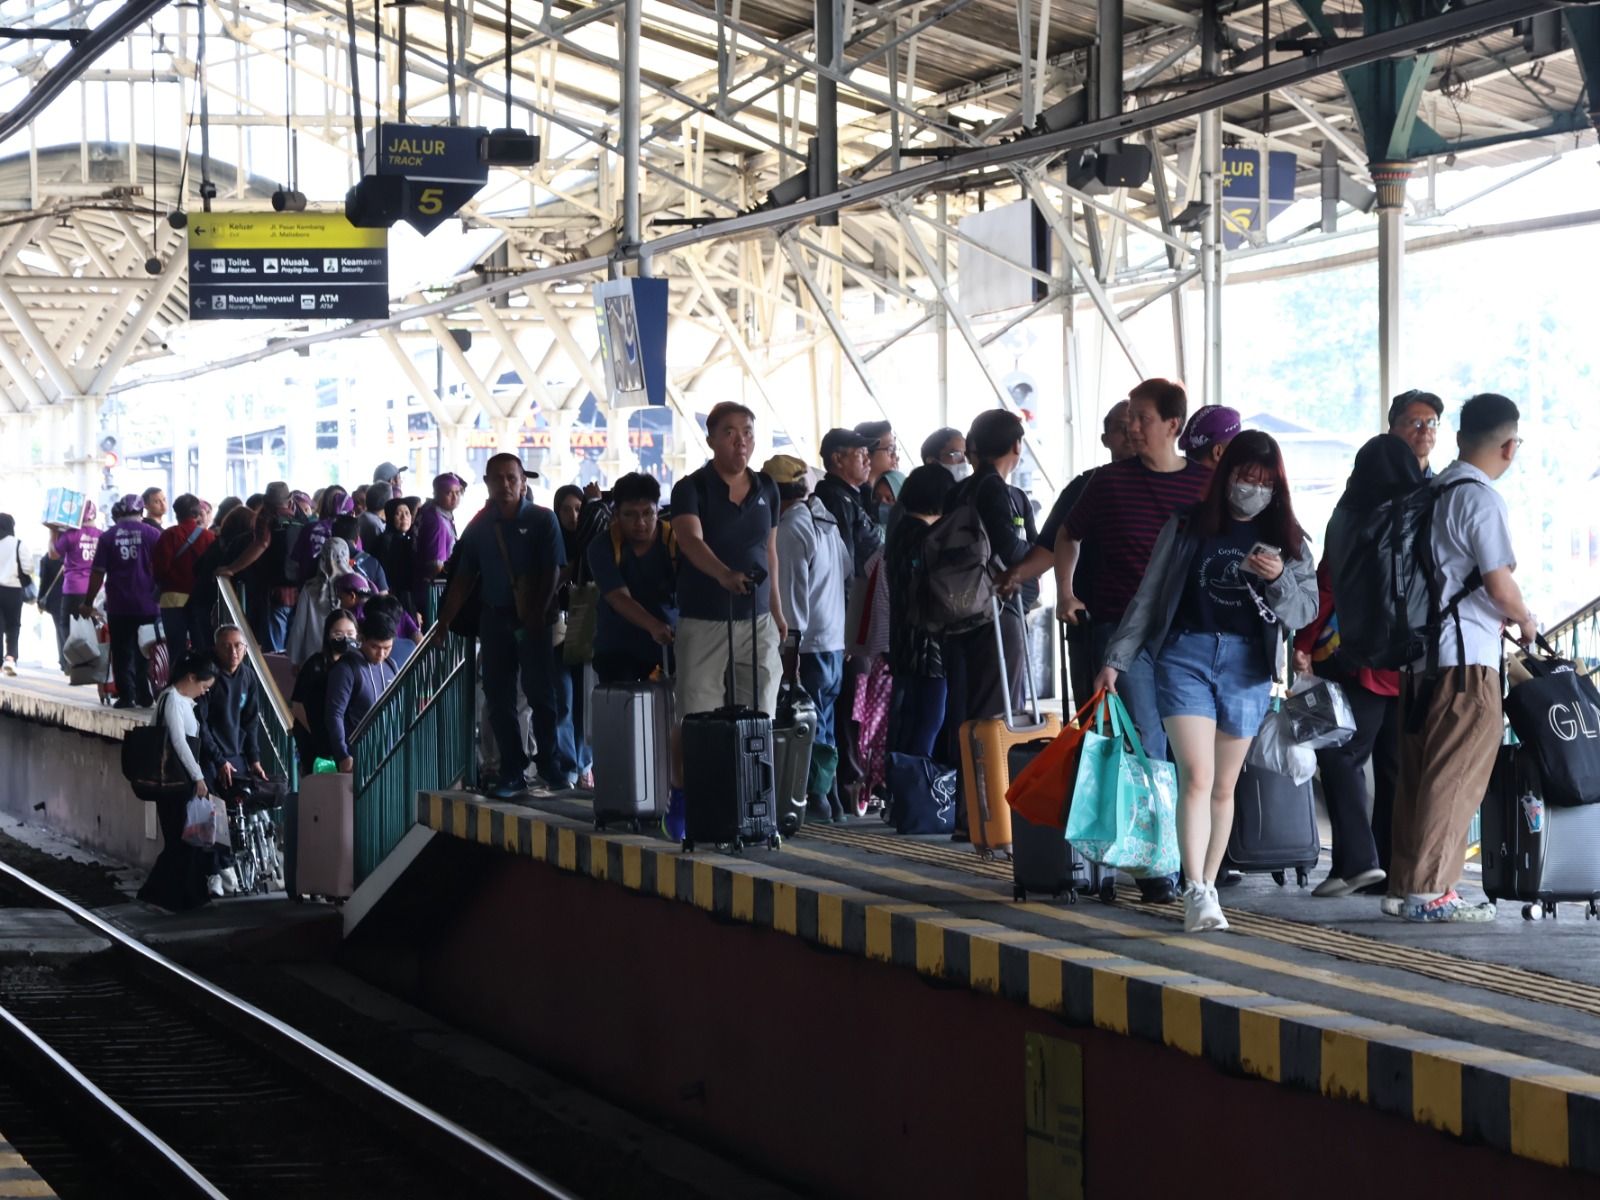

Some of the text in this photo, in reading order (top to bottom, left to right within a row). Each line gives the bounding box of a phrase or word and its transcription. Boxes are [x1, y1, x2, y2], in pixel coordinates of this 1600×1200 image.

[388, 138, 446, 156] JALUR
[388, 155, 424, 166] TRACK
[1221, 160, 1255, 177] LUR
[417, 188, 444, 215] 5
[228, 223, 254, 231] Keluar
[227, 258, 250, 266] Toilet
[280, 257, 309, 266] Musala
[341, 257, 382, 266] Keamanan
[341, 266, 364, 274] Security
[228, 294, 295, 304] Ruang Menyusui
[319, 294, 339, 303] ATM
[120, 546, 138, 560] 96
[1218, 547, 1247, 558] Gryffin
